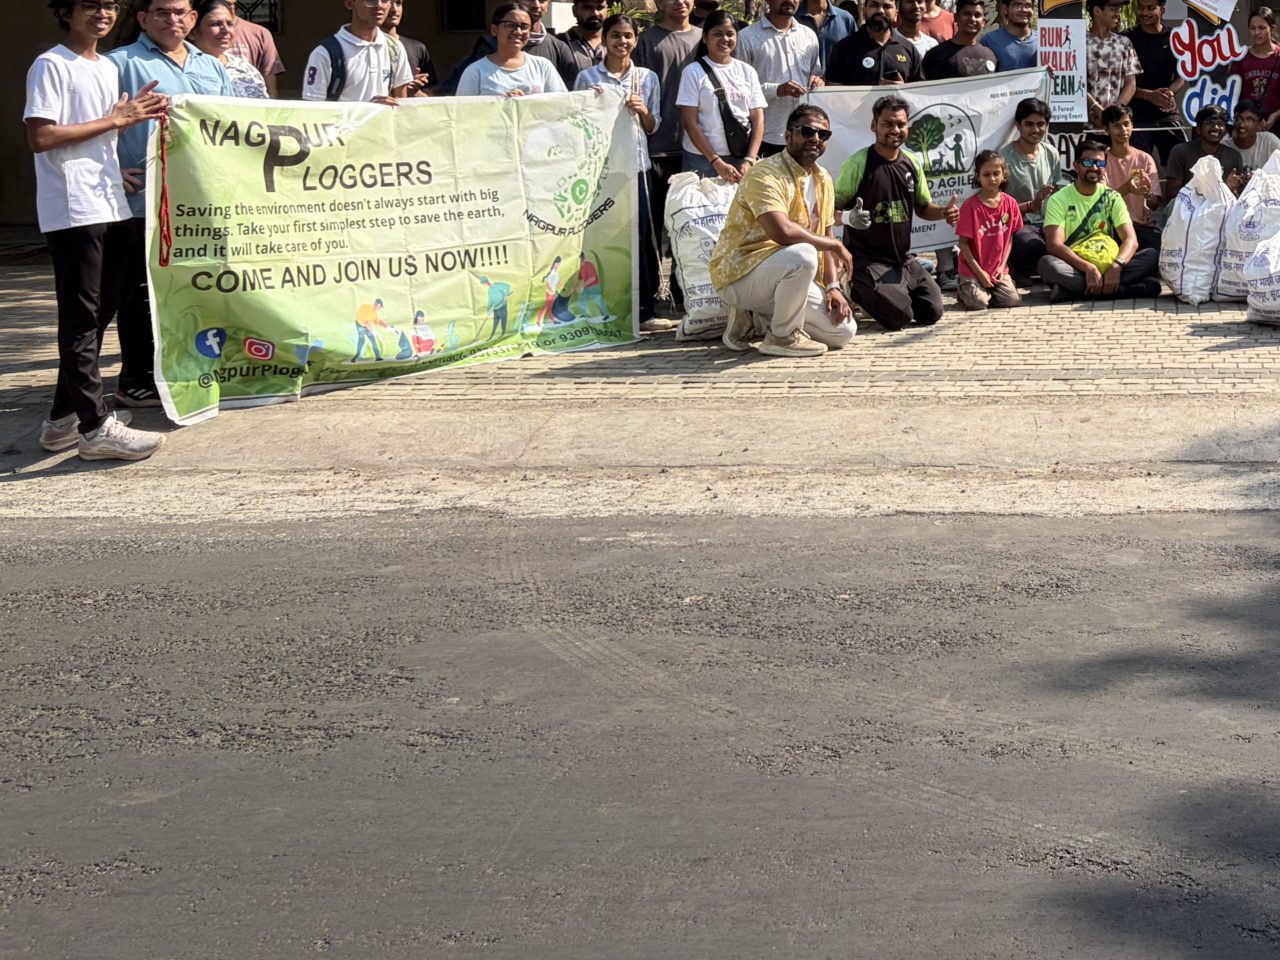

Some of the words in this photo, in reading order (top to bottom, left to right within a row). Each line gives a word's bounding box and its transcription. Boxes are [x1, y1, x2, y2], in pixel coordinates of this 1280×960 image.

[1040, 26, 1063, 48] RUN
[1172, 18, 1243, 79] You
[1040, 50, 1073, 71] WALK
[308, 66, 318, 86] 8
[1185, 78, 1237, 123] did
[938, 174, 974, 189] AGILE
[175, 204, 231, 220] Saving
[235, 202, 254, 216] the
[256, 201, 326, 216] environment
[329, 198, 372, 214] doesn't
[374, 197, 415, 212] always
[417, 193, 446, 207] start
[449, 191, 477, 205] with
[480, 189, 500, 203] big
[174, 223, 234, 240] things.
[237, 222, 265, 236] Take
[267, 222, 291, 237] your
[293, 219, 318, 234] first
[320, 217, 367, 233] simplest
[369, 216, 396, 231] step
[398, 213, 412, 226] to
[414, 212, 441, 225] save
[443, 208, 464, 222] the
[467, 206, 506, 221] earth,
[523, 209, 568, 237] NAGPUR
[173, 243, 208, 259] and
[213, 243, 227, 258] it
[231, 242, 252, 257] will
[255, 240, 284, 255] take
[285, 240, 309, 254] care
[310, 238, 324, 252] of
[326, 238, 349, 254] you.
[191, 268, 276, 293] COME
[281, 264, 326, 289] AND
[333, 257, 380, 284] JOIN
[388, 255, 418, 278] US
[425, 244, 509, 274] NOW!!!!
